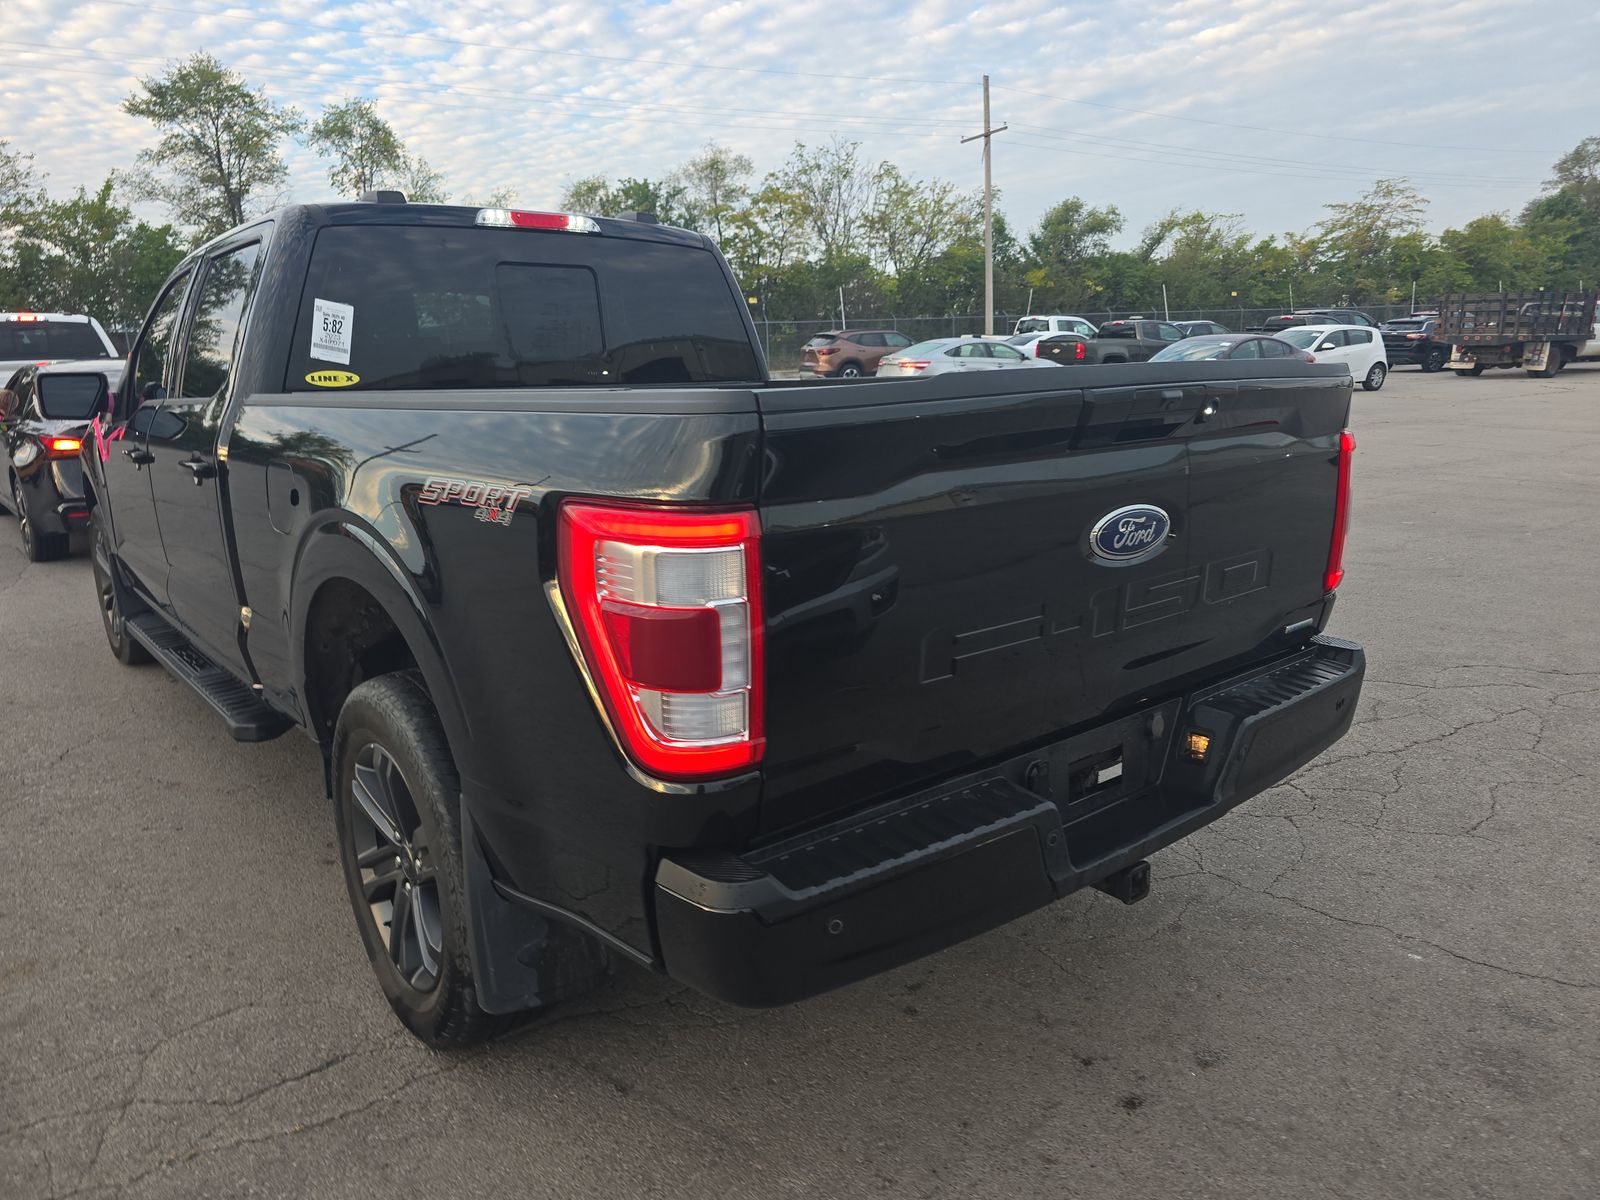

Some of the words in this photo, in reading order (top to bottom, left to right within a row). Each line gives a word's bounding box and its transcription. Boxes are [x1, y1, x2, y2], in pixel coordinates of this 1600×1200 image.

[323, 317, 343, 334] 5:82
[418, 477, 532, 512] SPORT
[1113, 516, 1157, 549] Ford
[919, 547, 1274, 684] F-150
